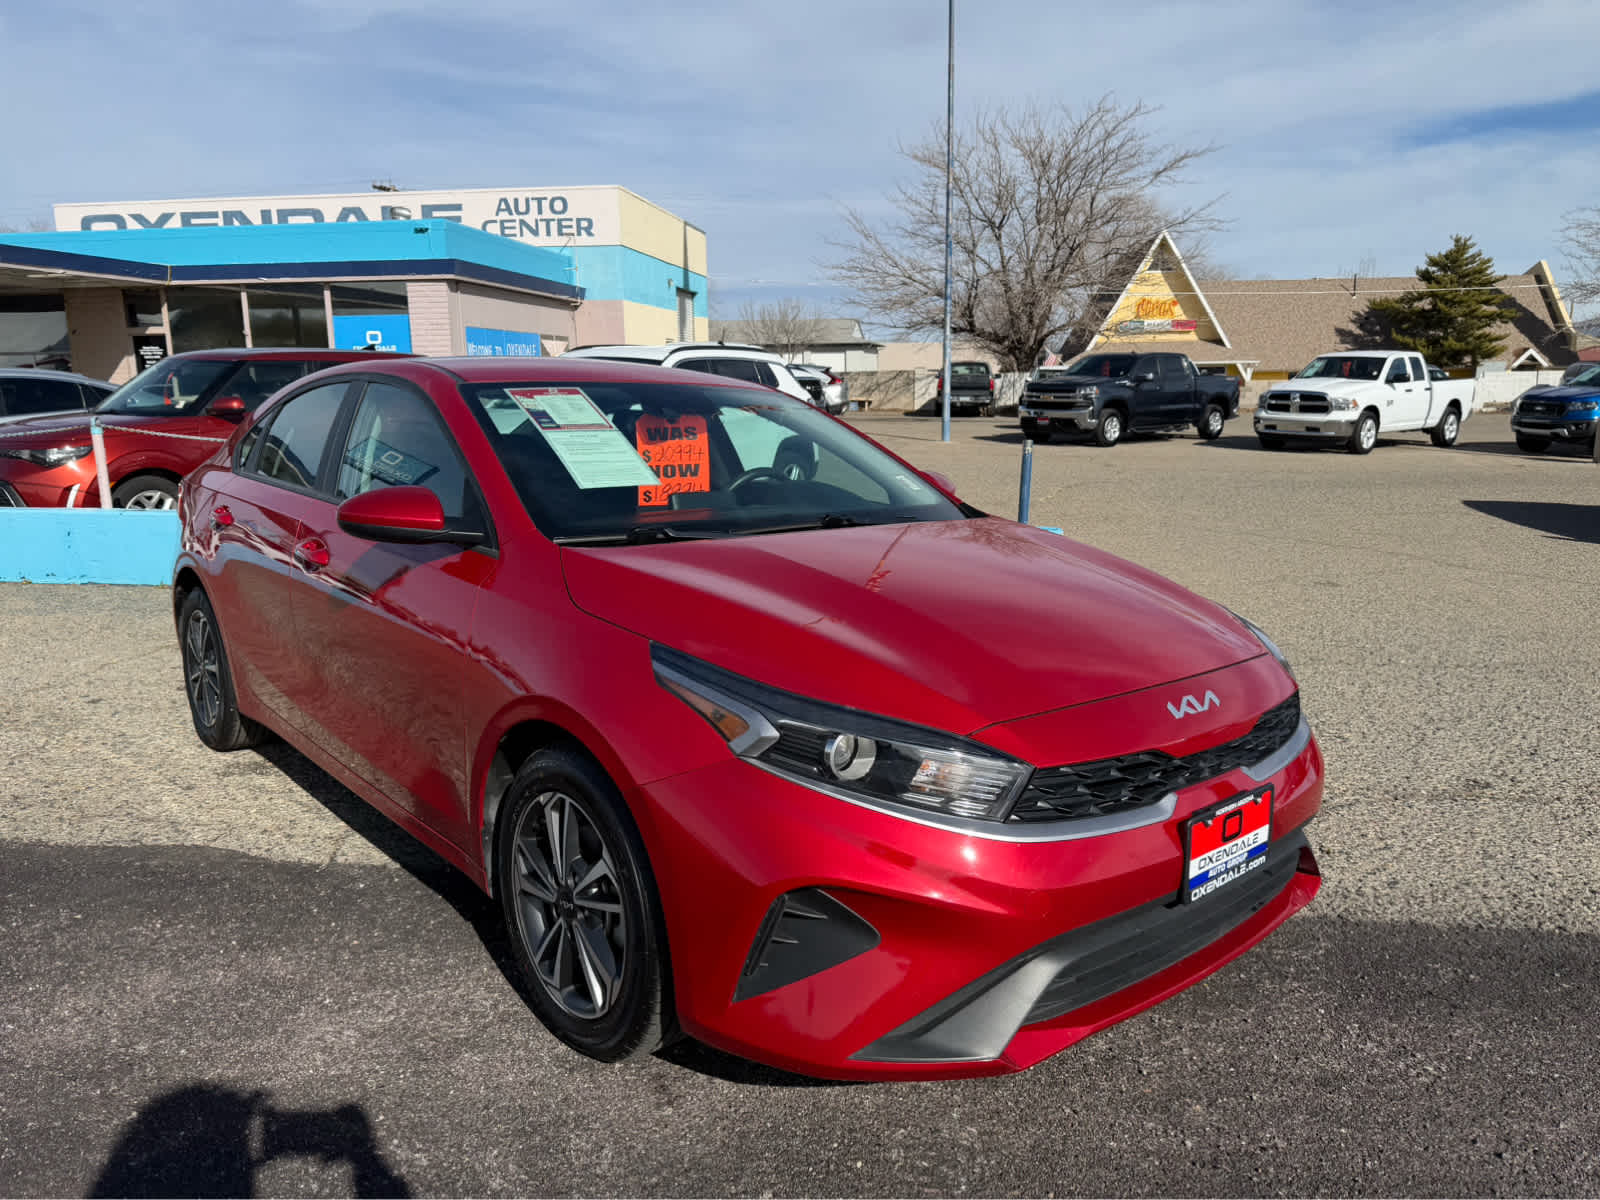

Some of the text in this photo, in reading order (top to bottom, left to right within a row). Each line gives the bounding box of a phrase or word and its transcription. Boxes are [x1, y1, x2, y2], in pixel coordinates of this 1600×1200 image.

[494, 196, 568, 216] AUTO
[481, 217, 595, 238] CENTER
[646, 426, 698, 441] WAS
[1167, 690, 1220, 719] KIA
[1198, 832, 1259, 870] OXENDALE
[1208, 852, 1249, 878] AUTO GROUP
[1191, 855, 1266, 902] OXENDALE.com
